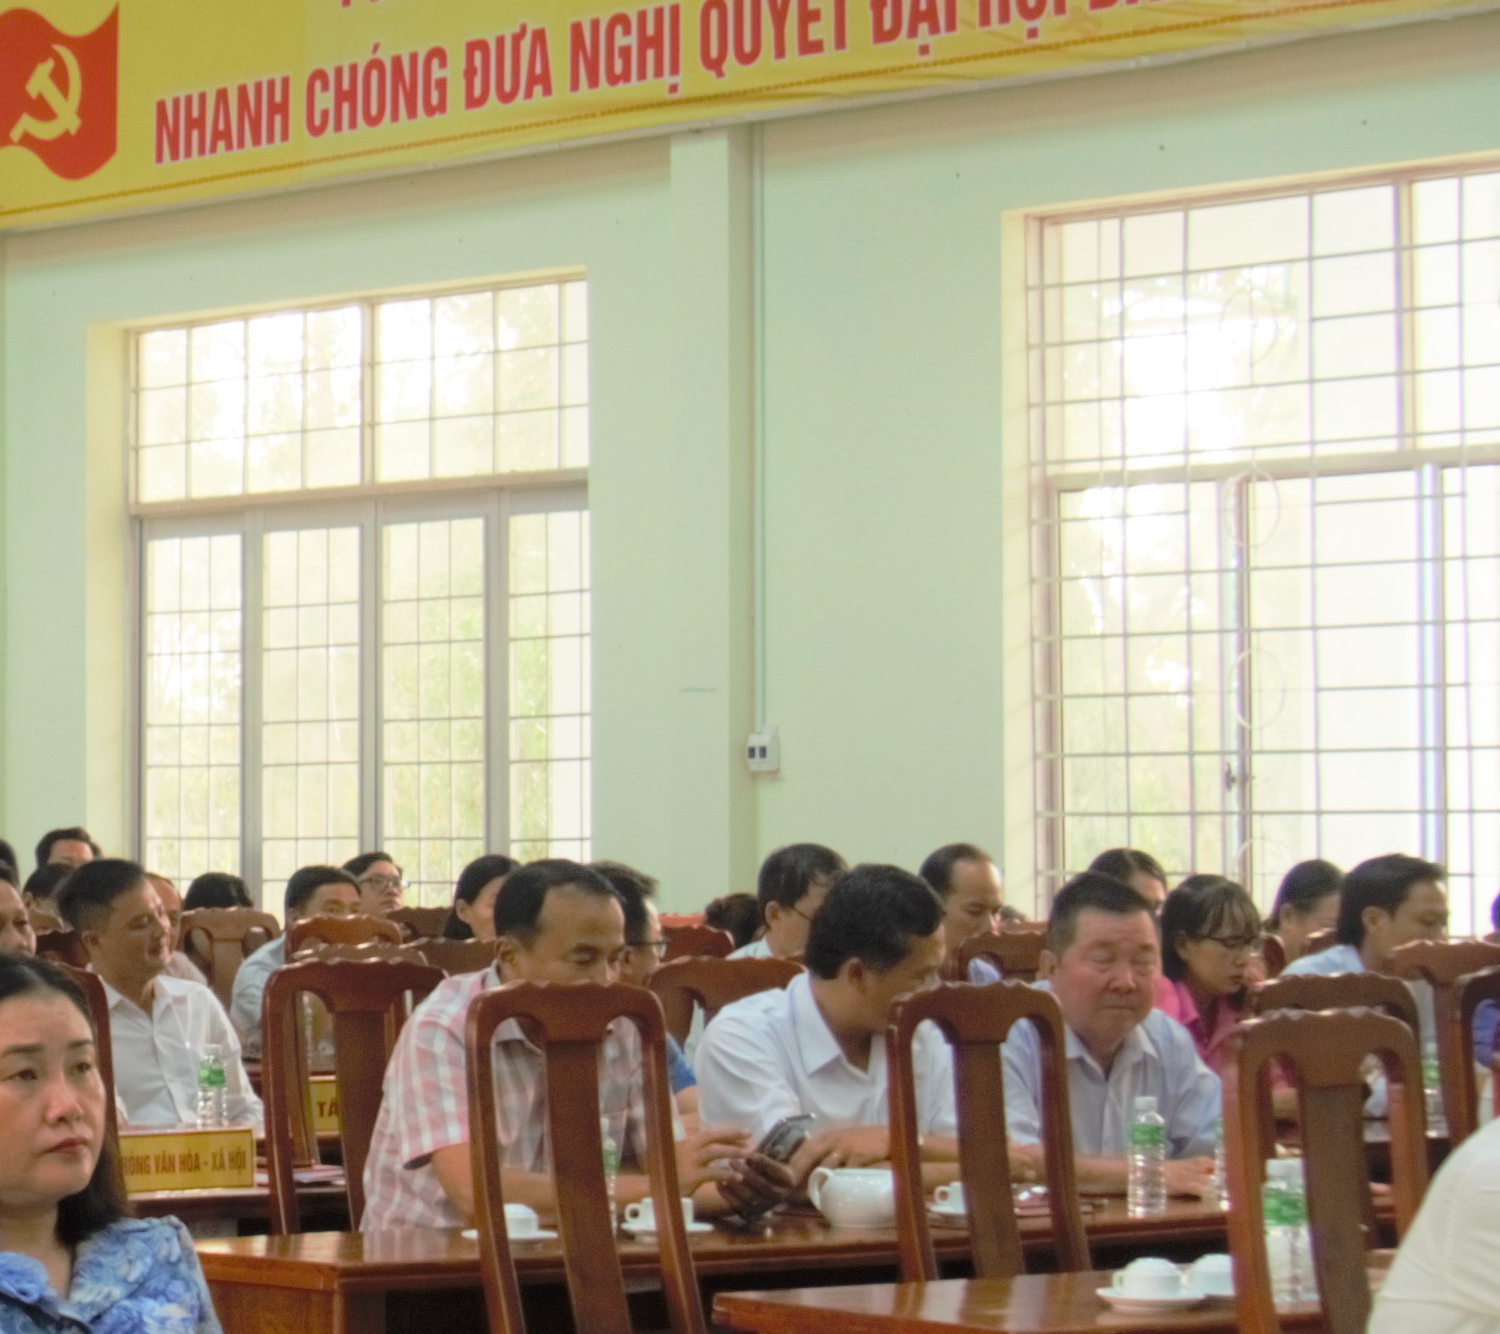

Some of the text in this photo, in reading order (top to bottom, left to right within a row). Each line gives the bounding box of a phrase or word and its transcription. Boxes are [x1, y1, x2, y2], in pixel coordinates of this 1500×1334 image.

[155, 75, 290, 164] NHANH
[305, 42, 447, 137] CHÓNG
[463, 23, 552, 111] ĐƯA
[570, 2, 681, 94] NGHỊ
